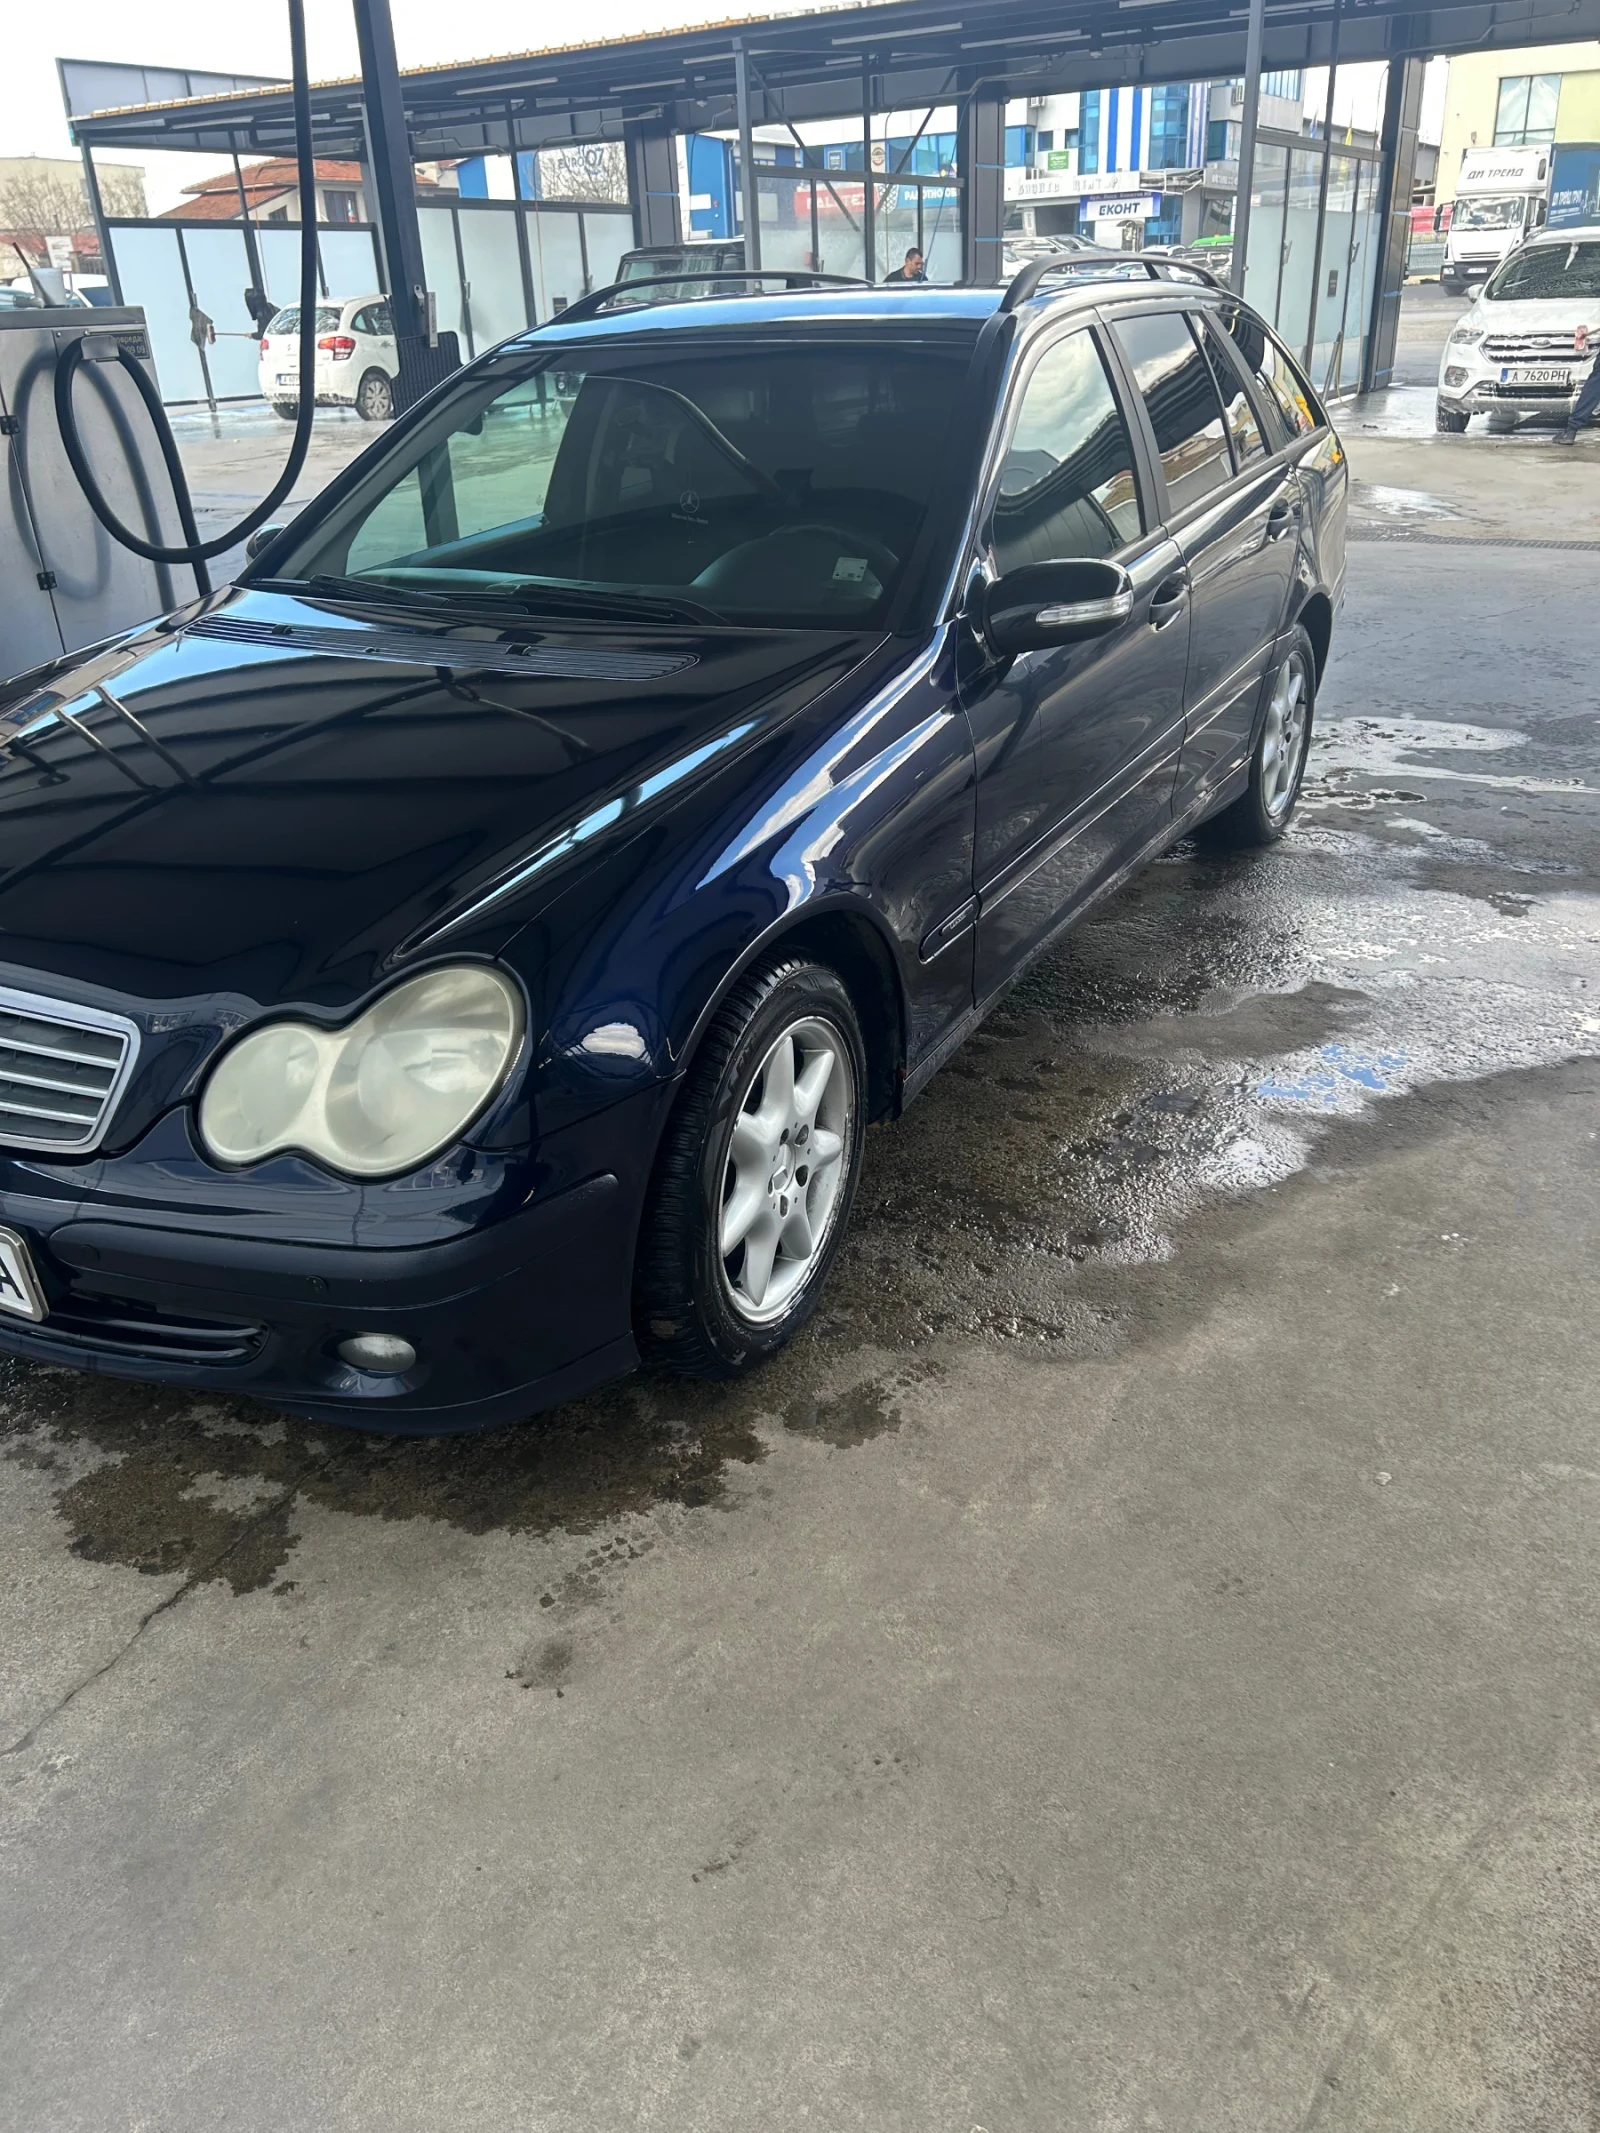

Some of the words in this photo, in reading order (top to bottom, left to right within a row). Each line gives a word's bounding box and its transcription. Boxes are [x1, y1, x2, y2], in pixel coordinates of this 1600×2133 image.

[1098, 202, 1141, 216] ЕКОНТ
[1523, 371, 1550, 382] 7620
[1550, 370, 1566, 381] PH
